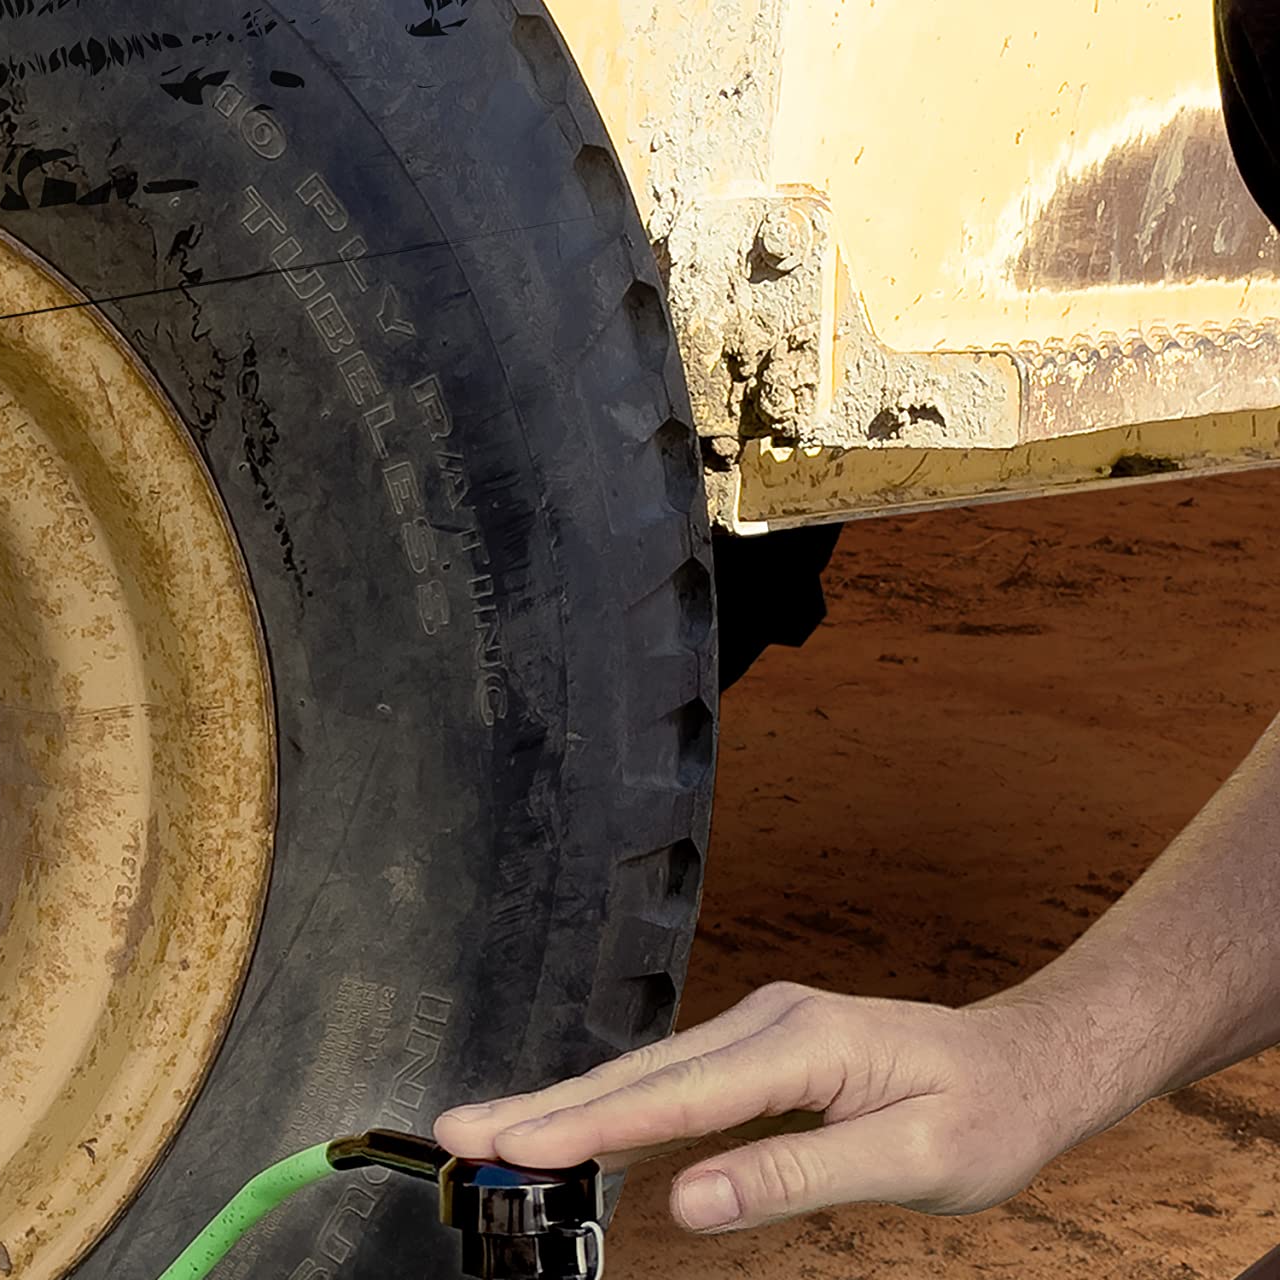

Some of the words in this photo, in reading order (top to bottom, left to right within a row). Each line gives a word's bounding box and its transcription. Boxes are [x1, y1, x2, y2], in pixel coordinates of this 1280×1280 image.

[241, 186, 451, 634] TUBELESS
[296, 172, 415, 341] PLY
[411, 372, 507, 726] RATING
